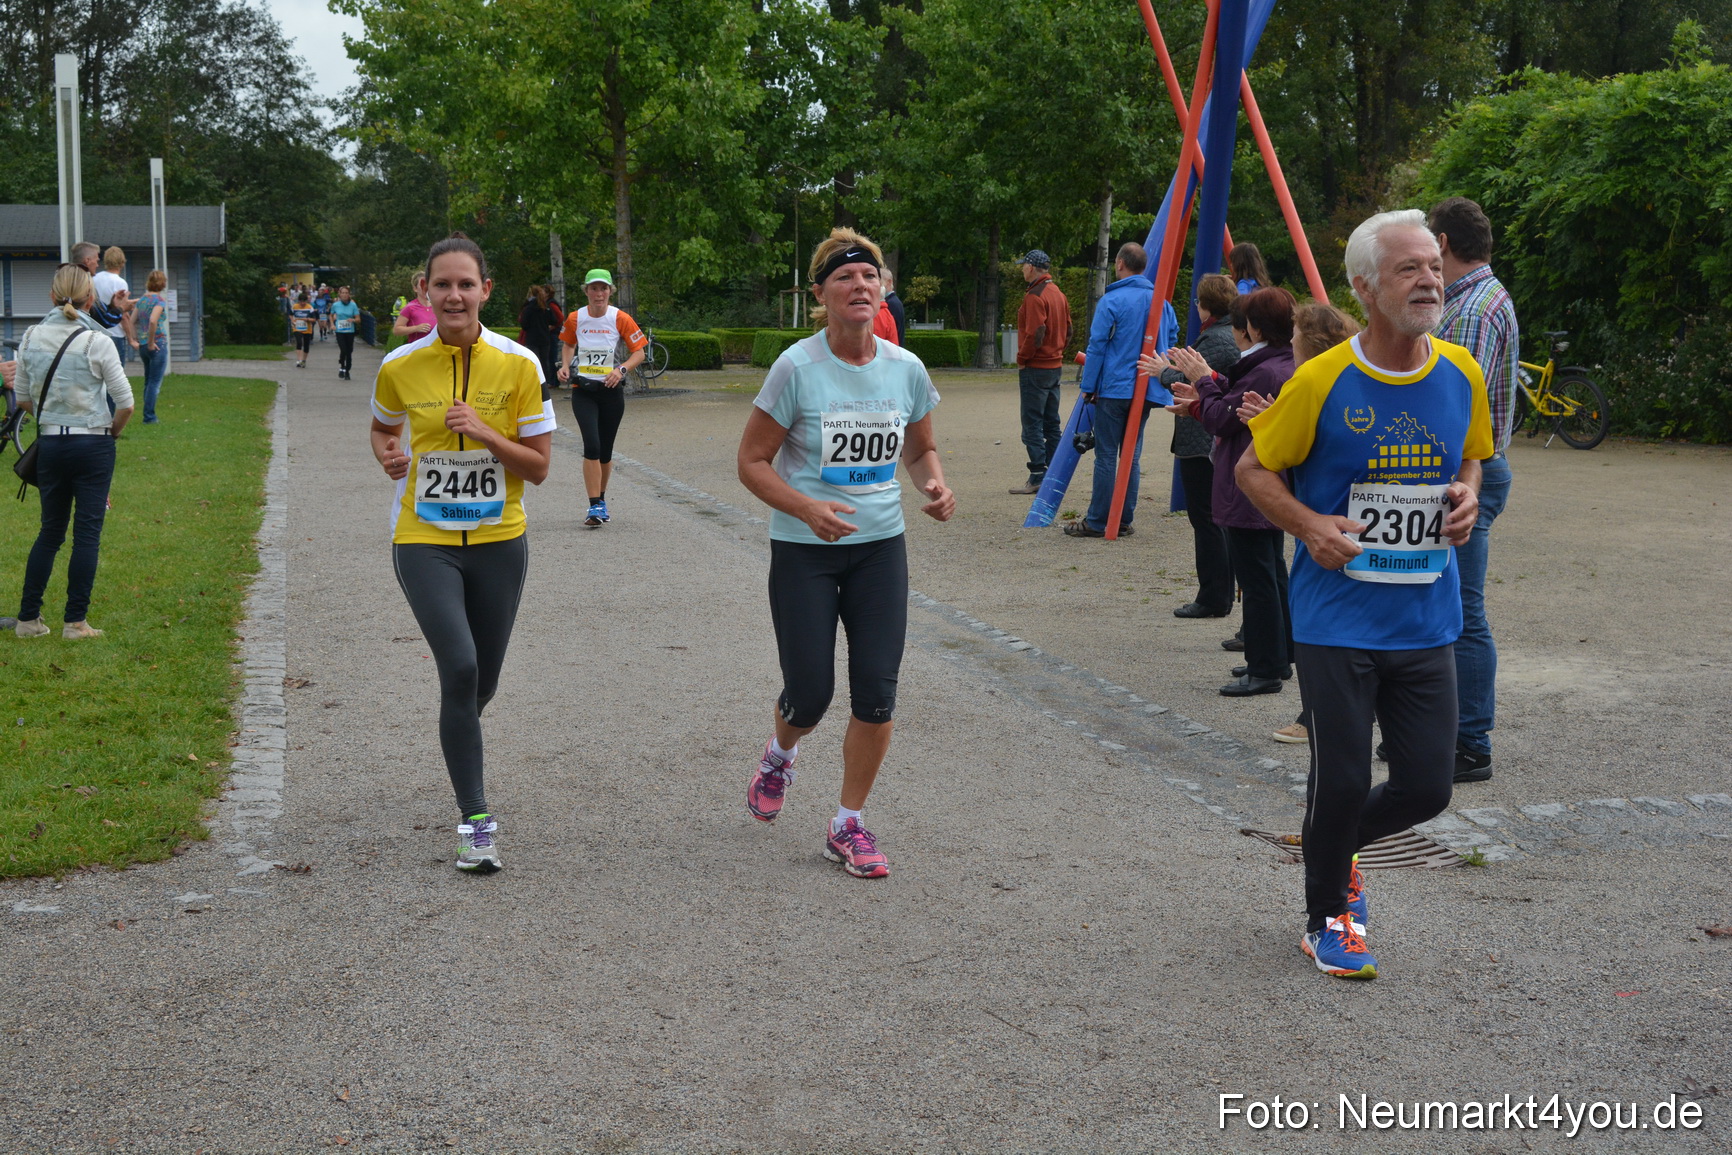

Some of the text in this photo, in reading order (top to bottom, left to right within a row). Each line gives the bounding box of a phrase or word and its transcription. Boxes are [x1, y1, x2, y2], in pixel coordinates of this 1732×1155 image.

[586, 354, 608, 366] 127
[824, 420, 853, 428] PARTL
[830, 432, 898, 462] 2909
[420, 456, 489, 466] PARTL Neumarkt
[424, 468, 497, 498] 2446
[849, 470, 876, 483] Karin
[1352, 492, 1439, 505] PARTL Neumarkt
[441, 506, 481, 518] Sabine
[1358, 508, 1443, 546] 2304
[1369, 553, 1429, 570] Raimund
